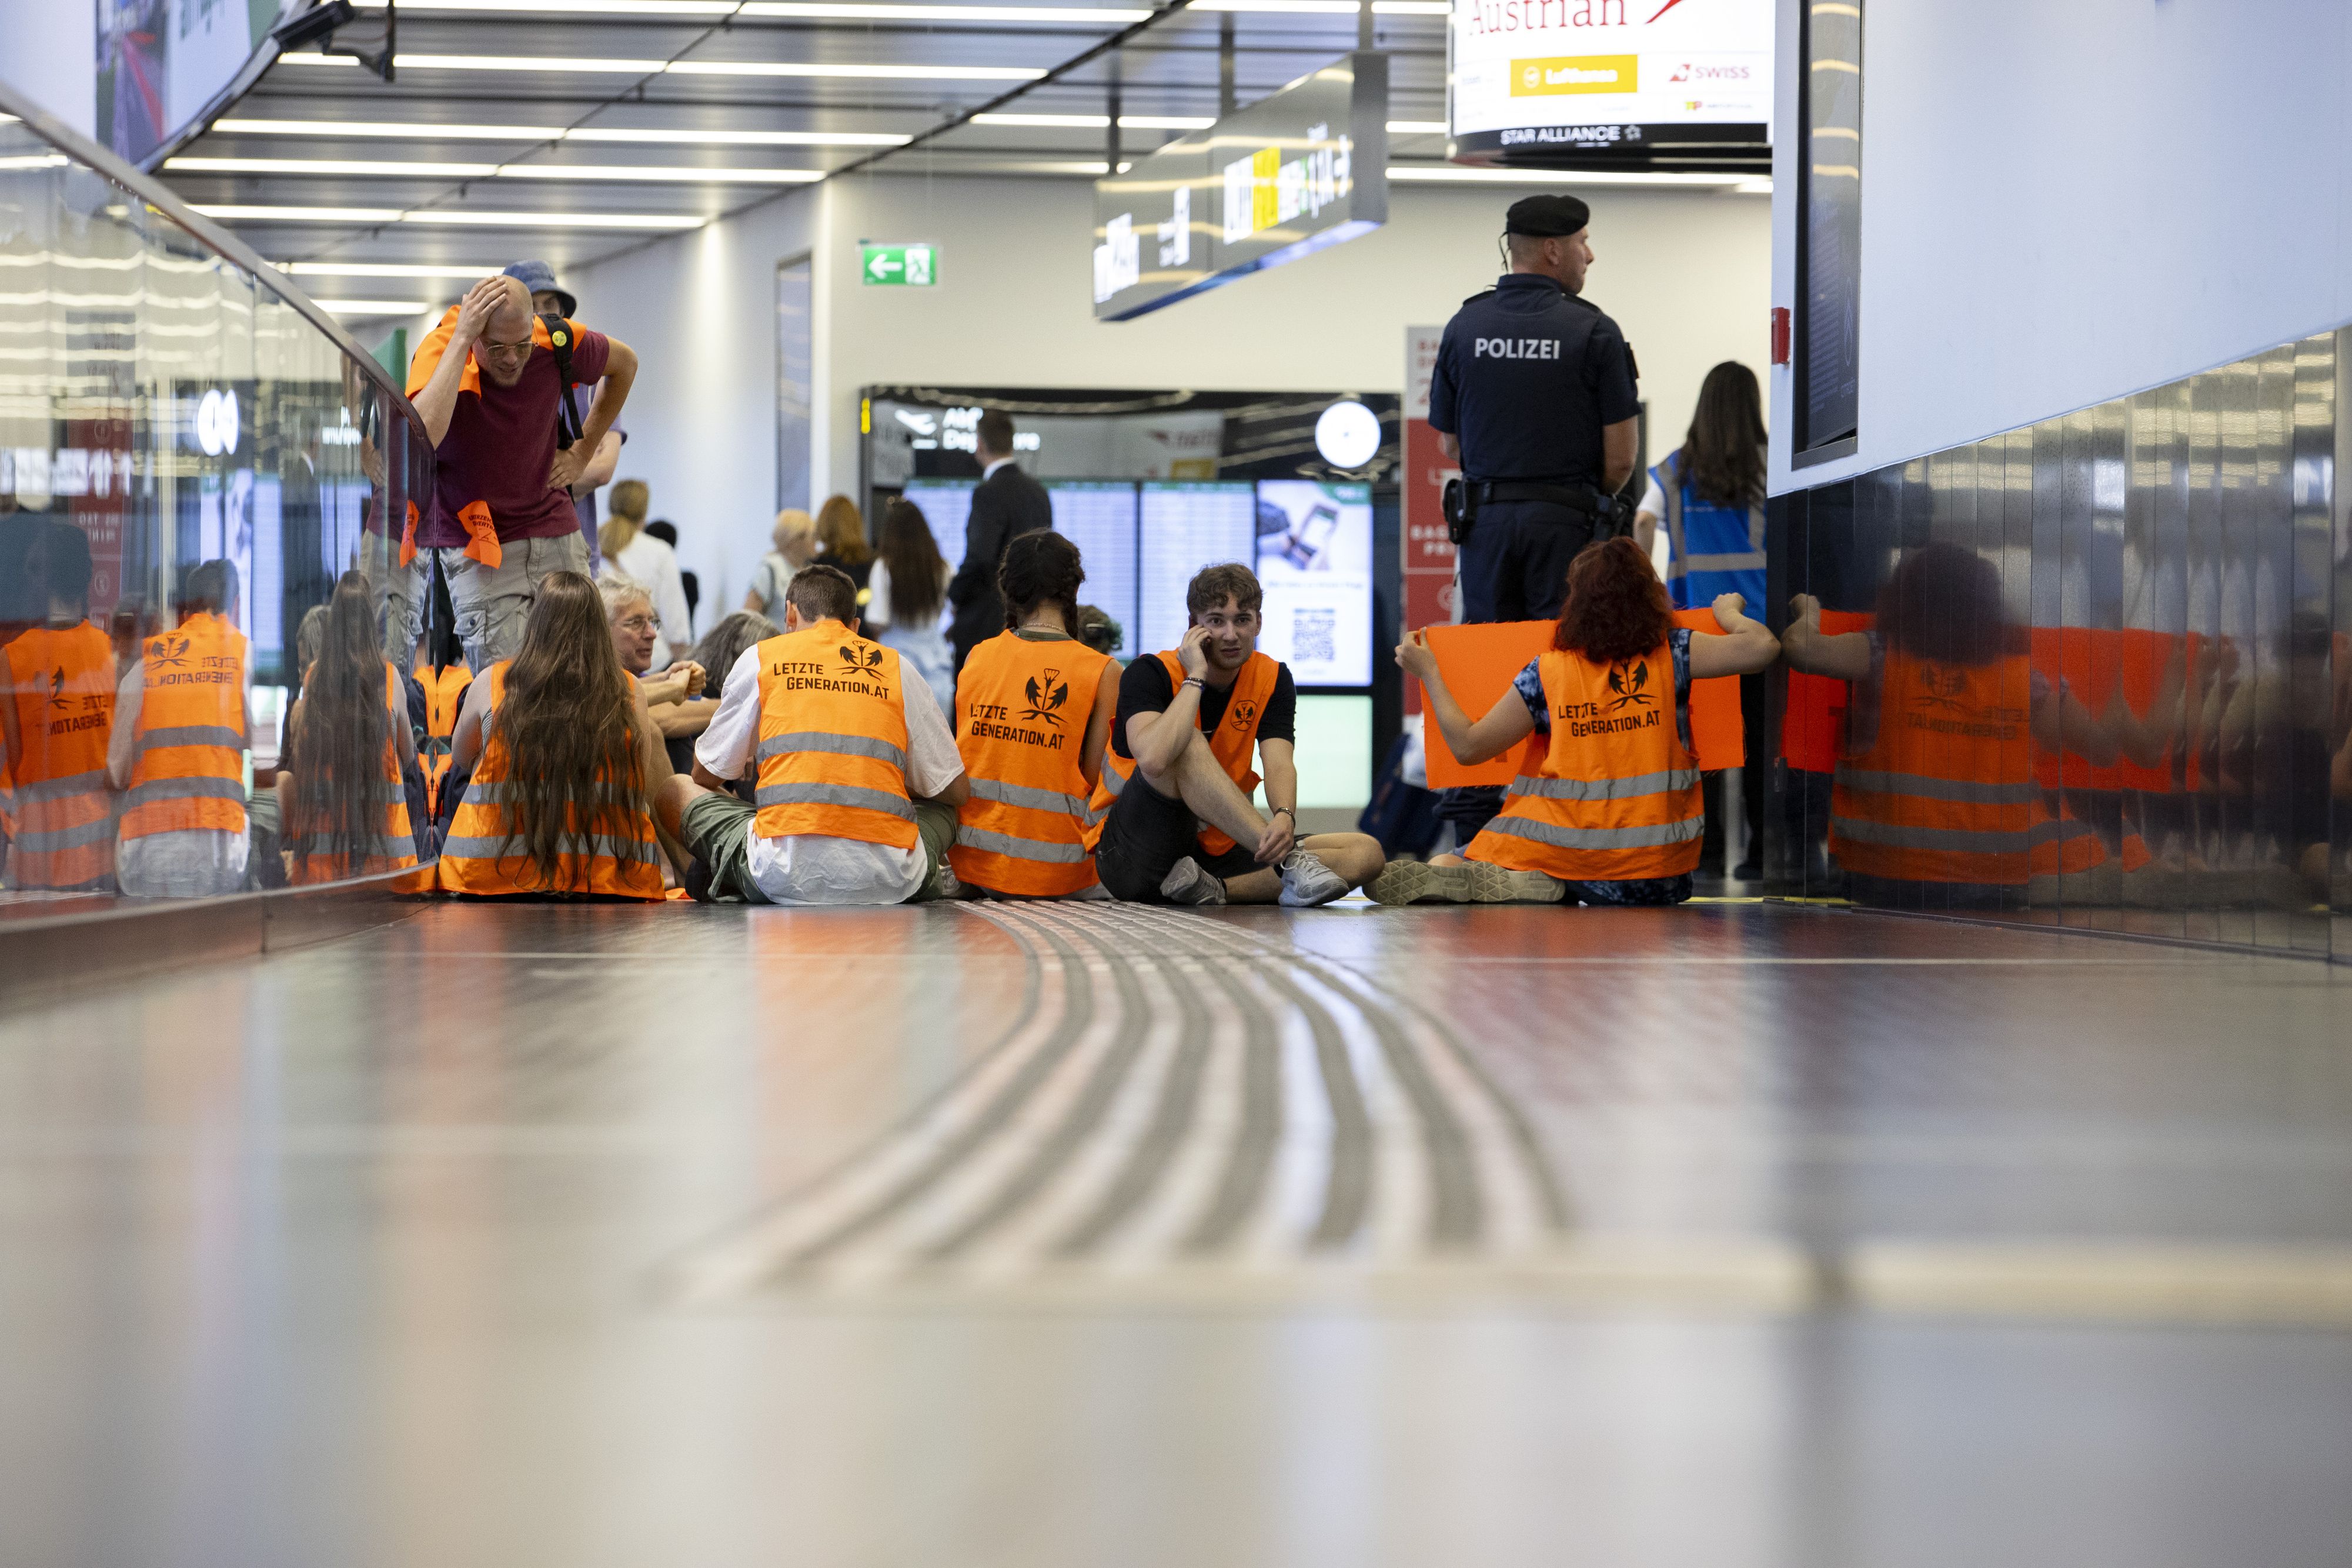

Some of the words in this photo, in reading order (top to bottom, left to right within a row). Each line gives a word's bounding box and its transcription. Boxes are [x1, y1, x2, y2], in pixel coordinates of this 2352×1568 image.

[1695, 66, 1750, 78] SWISS
[1501, 128, 1536, 145] STAR
[1536, 125, 1621, 143] ALLIANCE
[1475, 337, 1560, 359] POLIZEI
[774, 663, 824, 676] LETZTE
[787, 677, 889, 700] GENERATION.AT
[1572, 710, 1660, 737] GENERATION.AT
[971, 721, 1065, 750] GENERATION.AT
